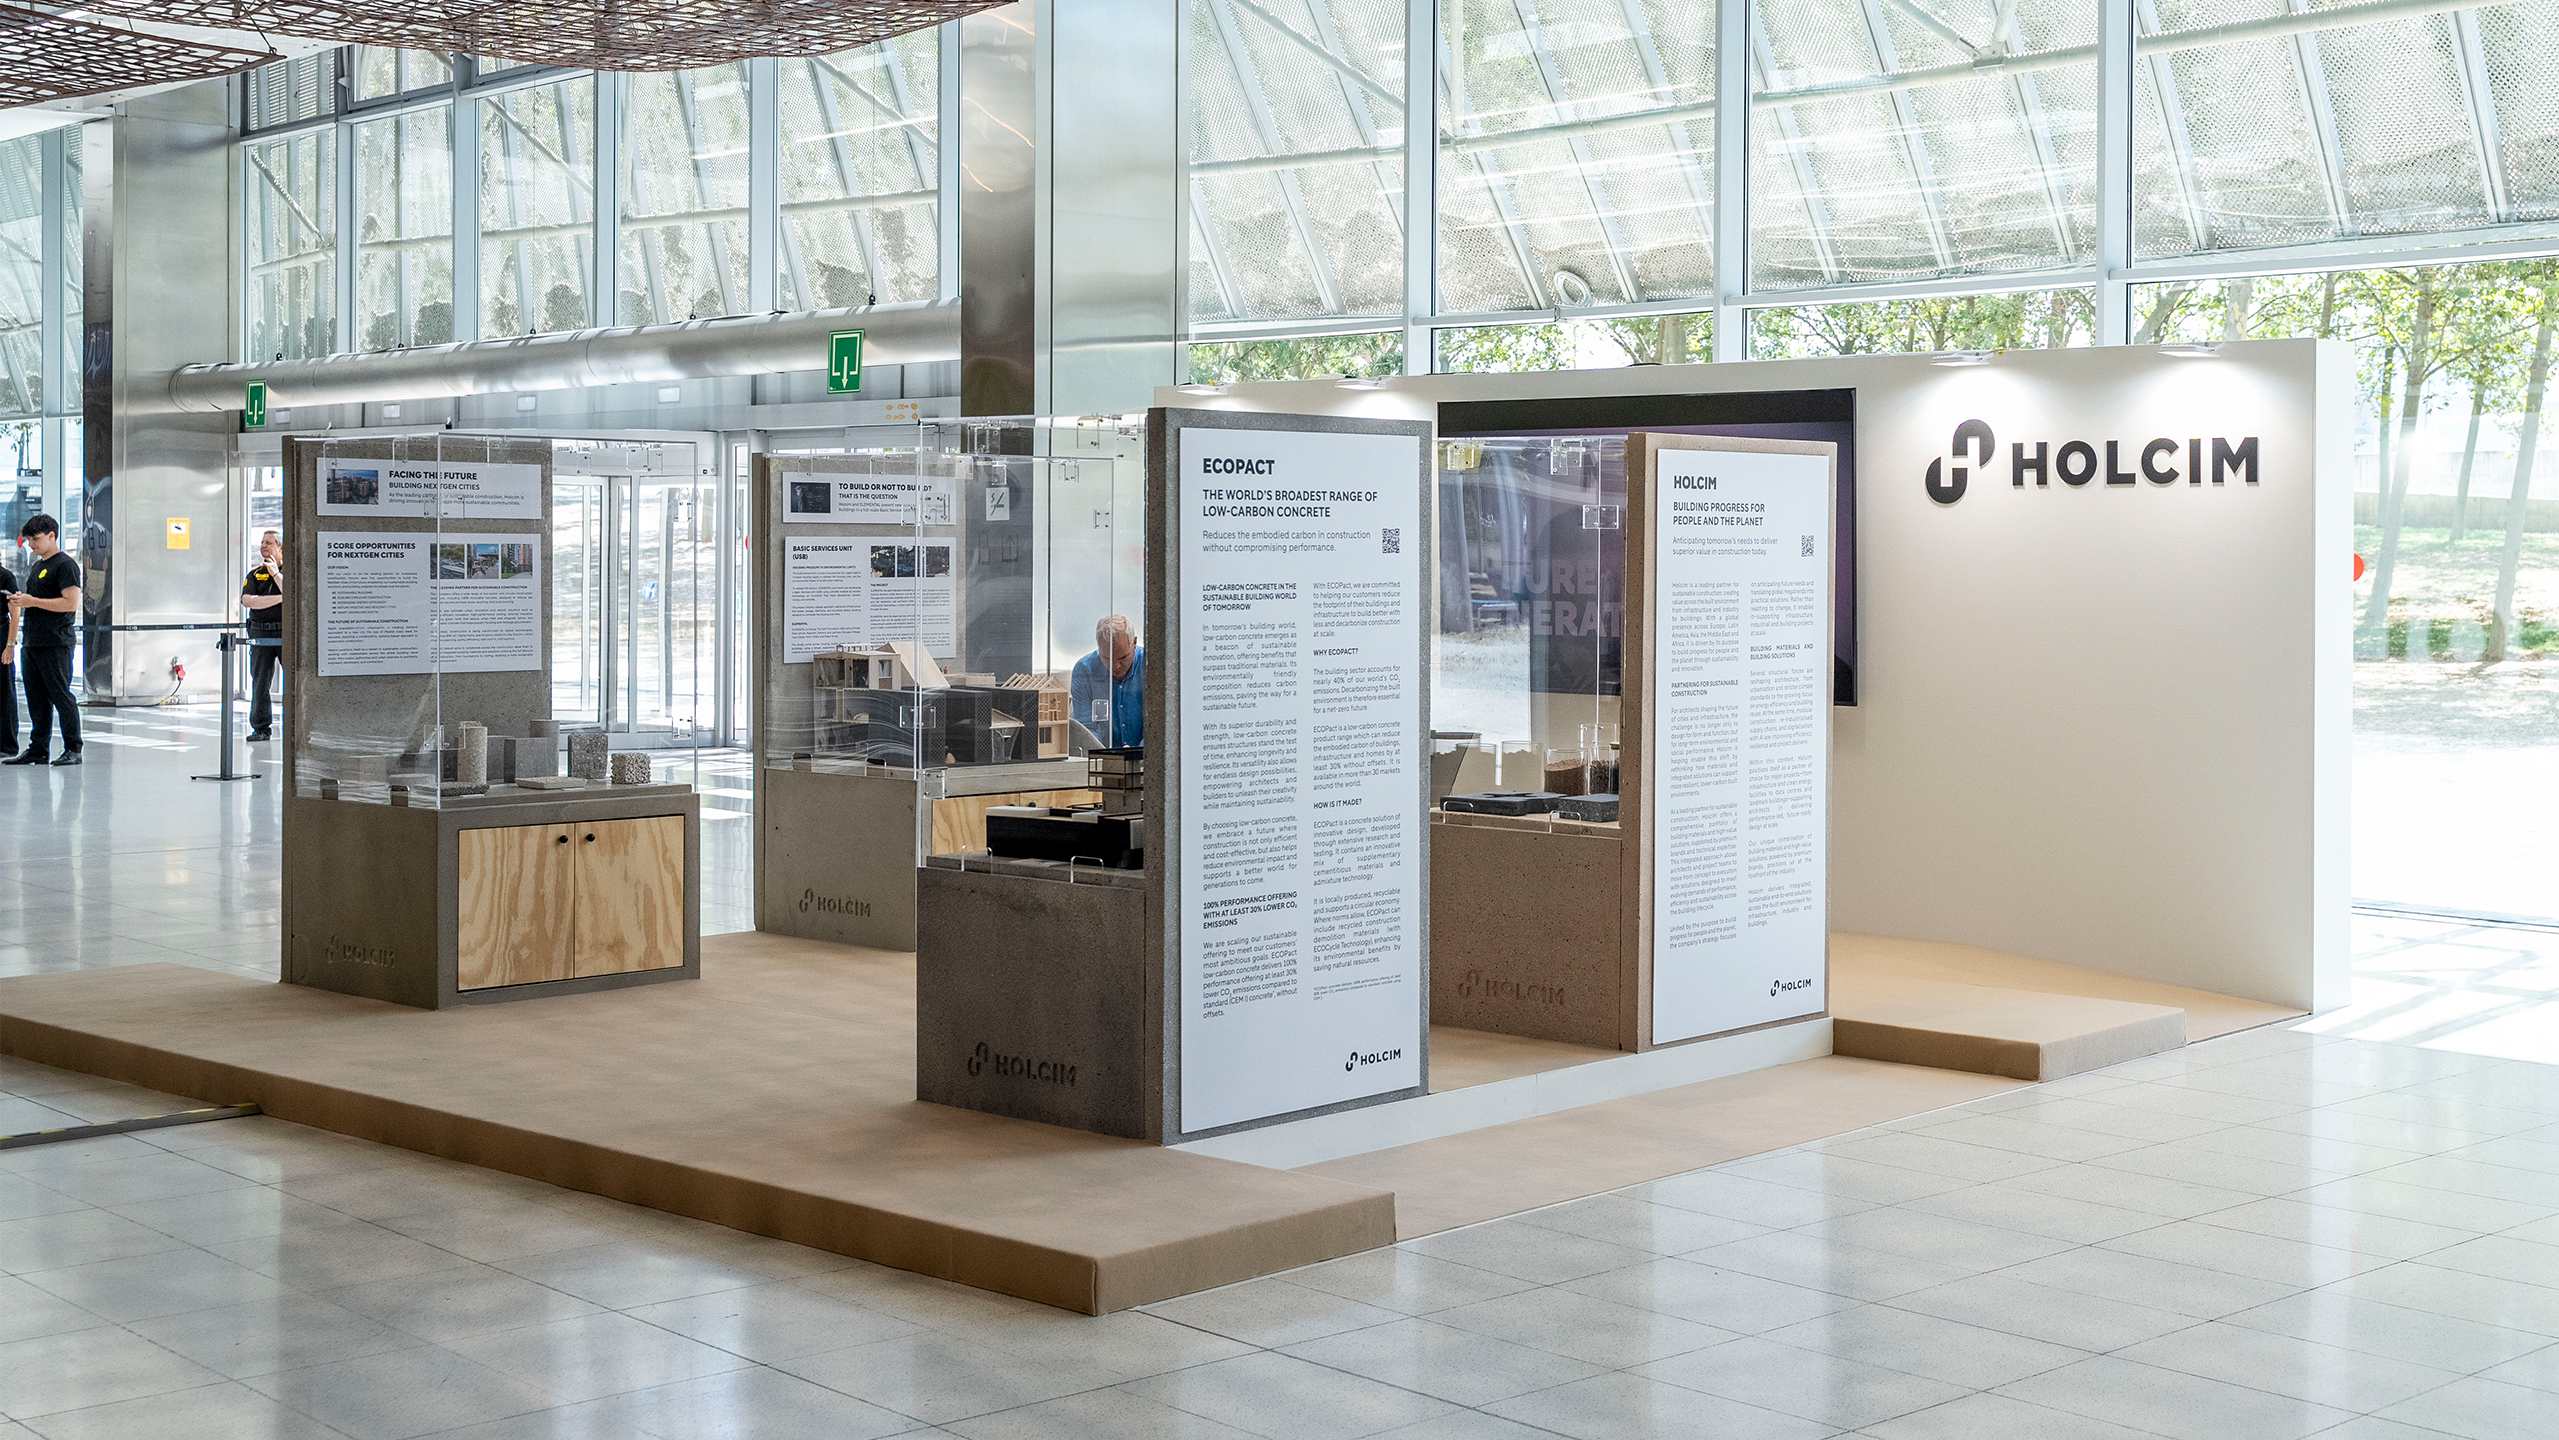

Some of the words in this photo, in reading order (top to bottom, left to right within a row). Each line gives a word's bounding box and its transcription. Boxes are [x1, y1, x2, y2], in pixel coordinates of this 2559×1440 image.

[1203, 458, 1275, 475] ECOPACT
[2012, 437, 2258, 489] HOLCIM
[389, 470, 422, 479] FACING
[444, 472, 477, 480] FUTURE
[1674, 475, 1717, 490] HOLCIM
[1203, 489, 1223, 500] THE
[1225, 489, 1273, 501] WORLD'S
[1275, 490, 1327, 501] BROADEST
[1329, 491, 1362, 502] RANGE
[1365, 491, 1377, 502] OF
[1203, 506, 1274, 517] LOW-CARBON
[1277, 506, 1330, 517] CONCRETE
[1673, 502, 1709, 512] BUILDING
[1710, 502, 1749, 513] PROGRESS
[1750, 503, 1765, 512] FOR
[1673, 516, 1702, 525] PEOPLE
[1703, 516, 1719, 526] AND
[1720, 516, 1735, 526] THE
[1736, 516, 1763, 526] PLANET
[1203, 530, 1236, 540] Reduces
[1237, 530, 1250, 539] the
[1251, 530, 1290, 539] embodied
[1291, 531, 1317, 539] carbon
[1326, 530, 1371, 539] construction
[1672, 536, 1706, 546] Anticipating
[1202, 543, 1232, 552] without
[1233, 543, 1287, 554] compromising
[1289, 543, 1336, 553] performance.
[1672, 547, 1695, 556] superior
[1751, 548, 1768, 556] today.
[1327, 582, 1353, 590] ECOPact,
[1203, 593, 1244, 601] SUSTAINABLE
[1212, 623, 1247, 631] tomorrow's
[1250, 622, 1275, 631] building
[1261, 641, 1297, 649] sustainable
[1236, 652, 1260, 660] offering
[1261, 651, 1284, 659] benefits
[1328, 648, 1358, 656] ECOPACT?
[1671, 689, 1707, 697] CONSTRUCTION
[1342, 798, 1362, 806] MADE?
[1203, 901, 1219, 910] 100%
[1220, 895, 1266, 907] PERFORMANCE
[1267, 891, 1297, 901] OFFERING
[817, 896, 871, 917] HOLCIM
[1203, 911, 1220, 919] WITH
[1230, 907, 1249, 916] LEAST
[1250, 905, 1262, 914] 30%
[1263, 902, 1285, 912] LOWER
[1203, 918, 1238, 930] EMISSIONS
[1781, 978, 1811, 992] HOLCIM
[1485, 979, 1564, 1006] HOLCIM
[1360, 1049, 1401, 1066] HOLCIM
[996, 1054, 1076, 1086] HOLCIM
